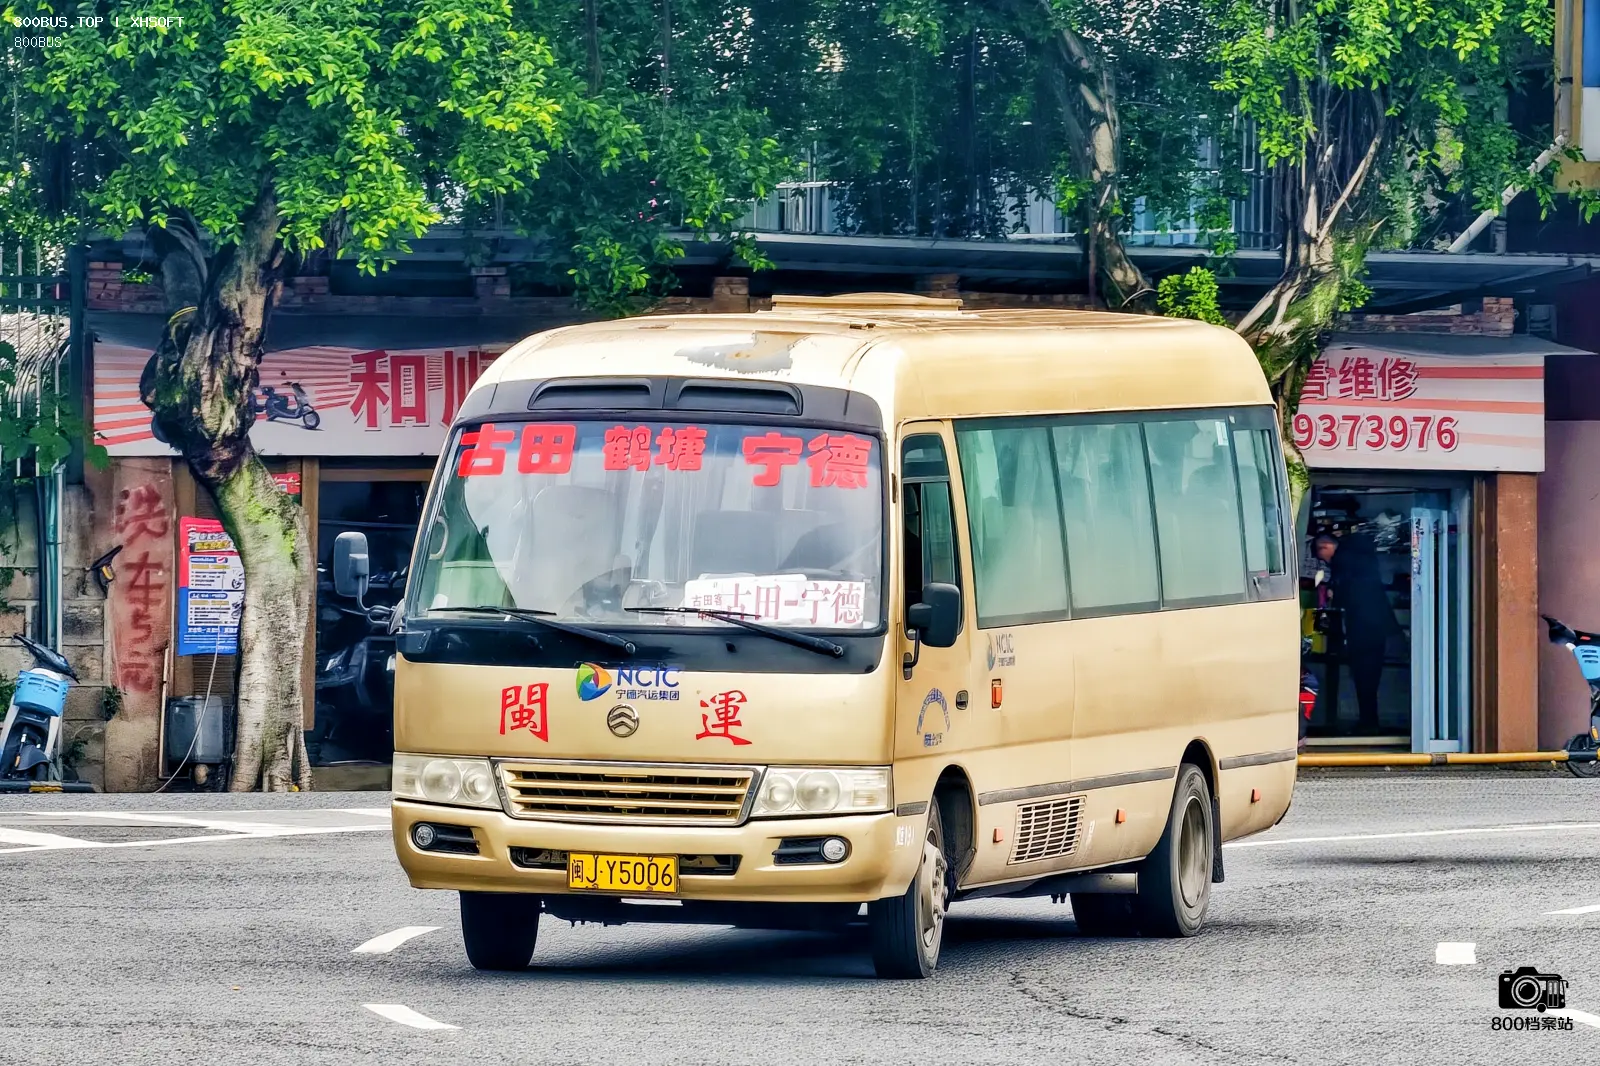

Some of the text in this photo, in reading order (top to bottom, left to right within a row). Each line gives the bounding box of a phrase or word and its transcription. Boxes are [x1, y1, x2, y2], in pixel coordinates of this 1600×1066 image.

[458, 423, 872, 489] 古田 鹤塘 宁德
[1293, 413, 1457, 450] 9373976
[499, 682, 753, 746] 閩 運
